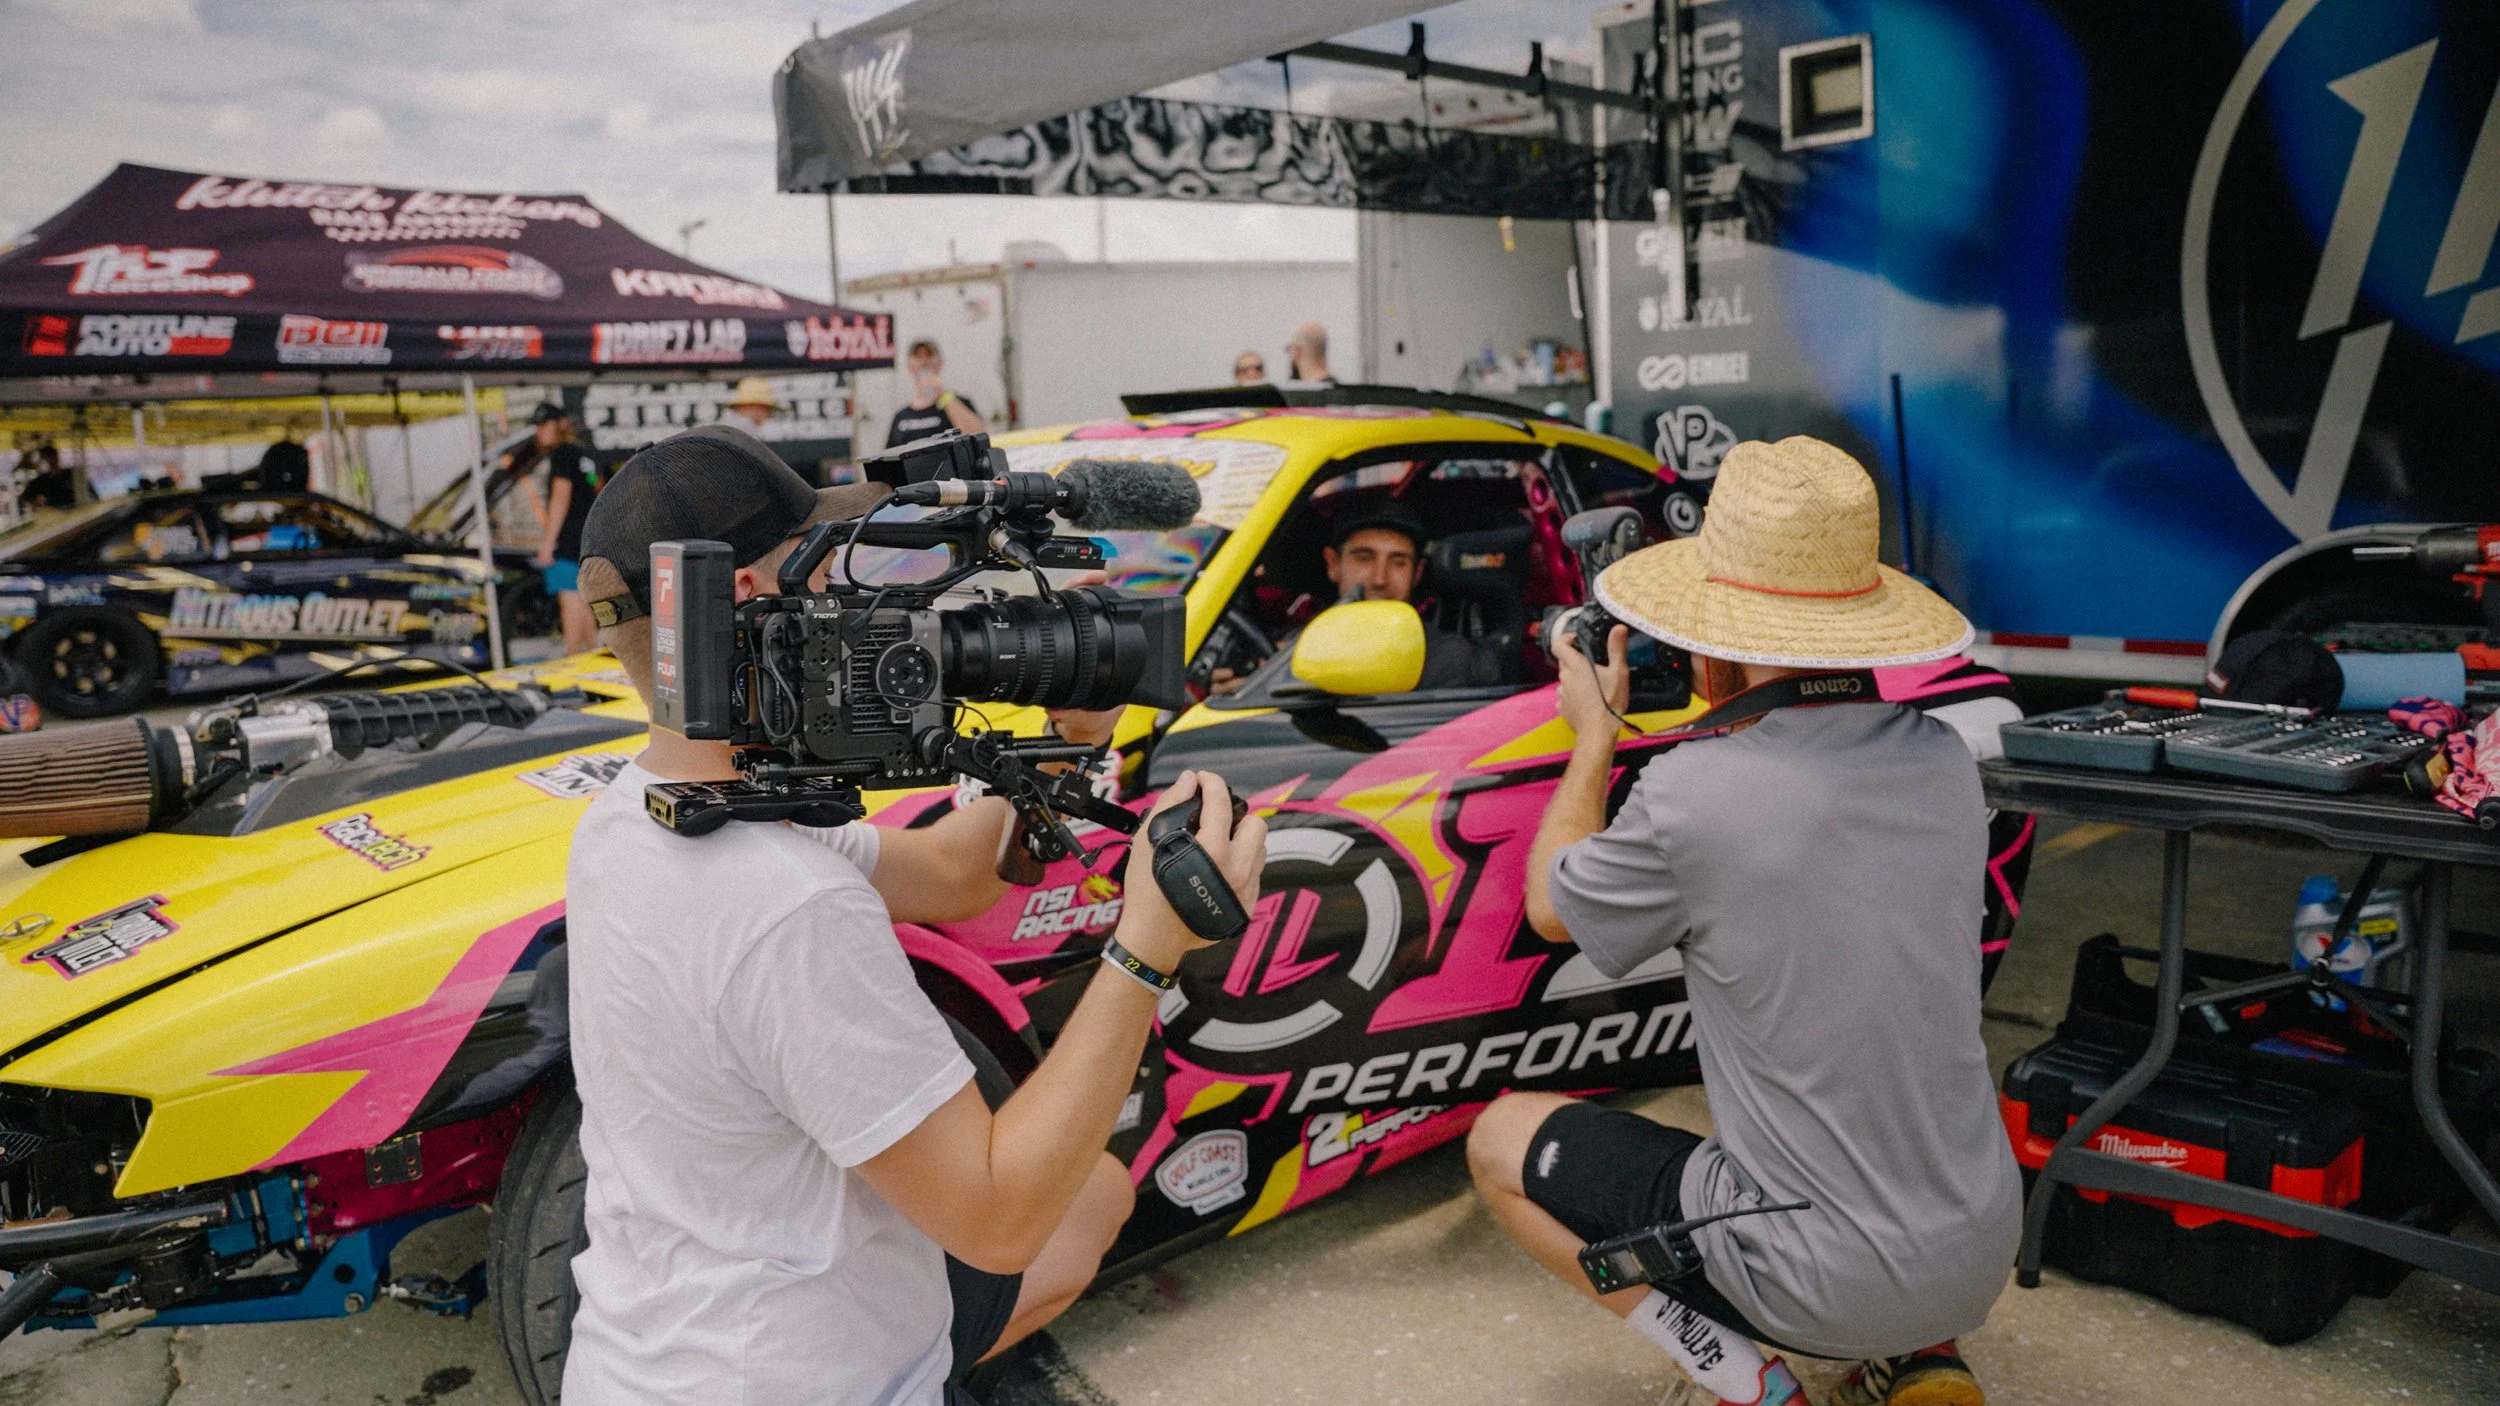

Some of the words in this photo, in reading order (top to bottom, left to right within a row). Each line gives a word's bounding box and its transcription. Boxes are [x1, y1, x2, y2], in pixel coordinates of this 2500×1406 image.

[79, 314, 237, 338] FORTUNE
[75, 335, 172, 356] AUTO
[300, 591, 409, 635] OUTLET
[1800, 677, 1862, 696] Canon
[1023, 883, 1078, 917] NSI
[1188, 875, 1223, 916] SONY
[1011, 897, 1125, 942] RACING
[1124, 957, 1142, 974] 22
[2097, 1133, 2188, 1160] Milwaukee
